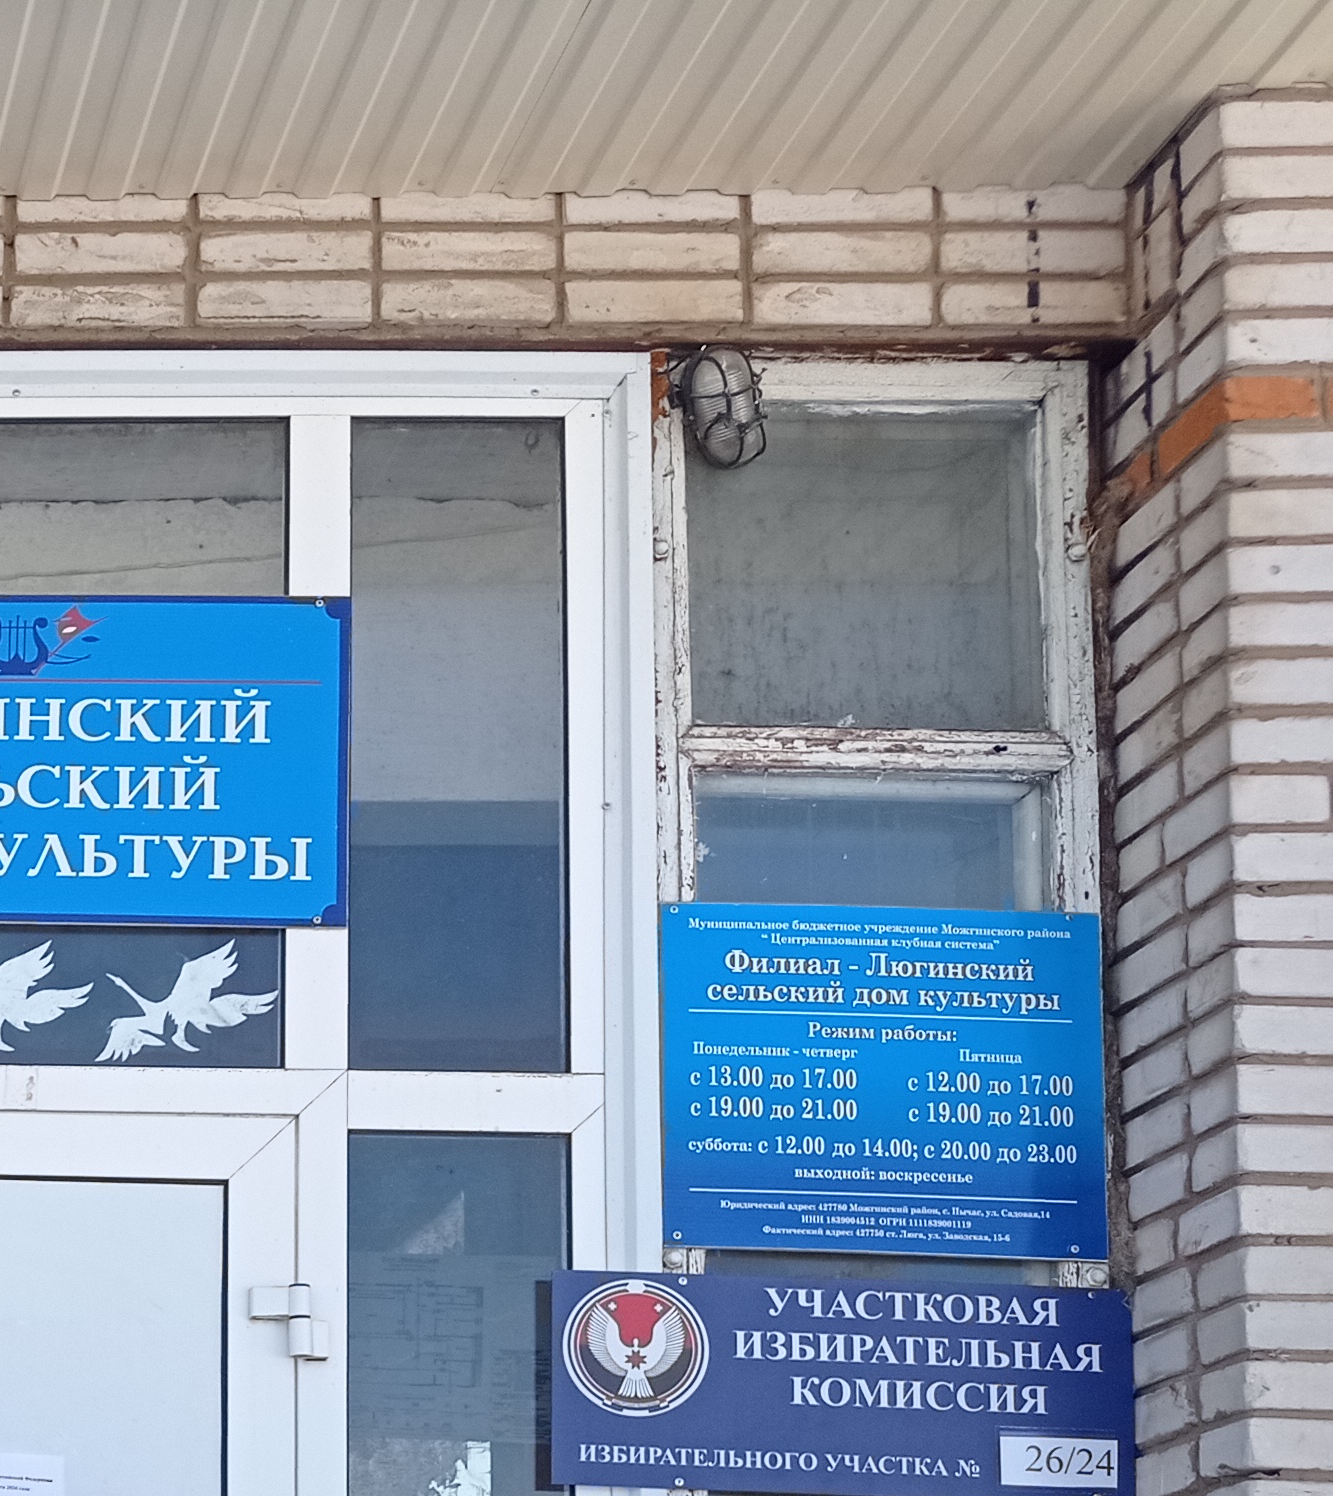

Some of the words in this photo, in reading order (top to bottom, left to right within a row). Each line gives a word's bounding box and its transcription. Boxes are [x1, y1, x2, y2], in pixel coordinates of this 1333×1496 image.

[688, 918, 789, 930] Муниципальное
[792, 920, 861, 931] бюджетное
[864, 924, 938, 935] учреждение
[942, 924, 1024, 937] Можгинского
[1027, 928, 1071, 939] района
[771, 933, 888, 946] Централизованная
[892, 938, 941, 949] клубная
[725, 949, 840, 974] Филиал
[866, 953, 1034, 982] Люгинский
[706, 981, 844, 1004] сельский
[853, 986, 909, 1008] дом
[918, 990, 1060, 1014] культуры
[808, 1022, 874, 1039] Режим
[881, 1025, 957, 1043] работы:
[693, 1041, 790, 1056] Понедельник
[802, 1050, 858, 1060] четверг
[959, 1049, 1022, 1064] Пятница
[690, 1072, 701, 1086] с
[708, 1066, 763, 1086] 13.00
[770, 1076, 794, 1090] до
[802, 1068, 857, 1089] 17.00
[908, 1077, 919, 1090] с
[926, 1072, 981, 1093] 12.00
[987, 1081, 1011, 1095] до
[1019, 1075, 1073, 1096] 17.00
[690, 1102, 701, 1116] с
[709, 1096, 764, 1117] 19.00
[770, 1106, 794, 1120] до
[802, 1099, 857, 1120] 21.00
[909, 1108, 919, 1121] с
[926, 1102, 981, 1123] 19.00
[988, 1111, 1012, 1127] до
[1019, 1105, 1074, 1127] 21.00
[688, 1138, 752, 1153] суббота:
[758, 1140, 768, 1153] с
[775, 1136, 825, 1155] 12.00
[832, 1142, 855, 1157] до
[862, 1138, 918, 1161] 14.00;
[924, 1145, 935, 1158] с
[941, 1141, 990, 1159] 20.00
[997, 1148, 1021, 1163] до
[1027, 1144, 1077, 1163] 23.00
[795, 1167, 874, 1180] выходной:
[879, 1171, 973, 1184] воскресенье
[720, 1200, 785, 1210] Юридический
[849, 1203, 909, 1214] Можгинский
[762, 1225, 823, 1236] Фактический
[802, 1215, 824, 1223] ИНН
[879, 1218, 906, 1226] ОГРН
[765, 1287, 1058, 1326] УЧАСТКОВАЯ
[733, 1330, 1102, 1372] ИЗБИРАТЕЛЬНАЯ
[790, 1376, 1048, 1414] КОМИССИЯ
[579, 1444, 817, 1472] ИЗБИРАТЕЛЬНОГО
[825, 1452, 948, 1477] УЧАСТКА
[956, 1459, 980, 1478] №
[1025, 1444, 1115, 1476] 26/24
